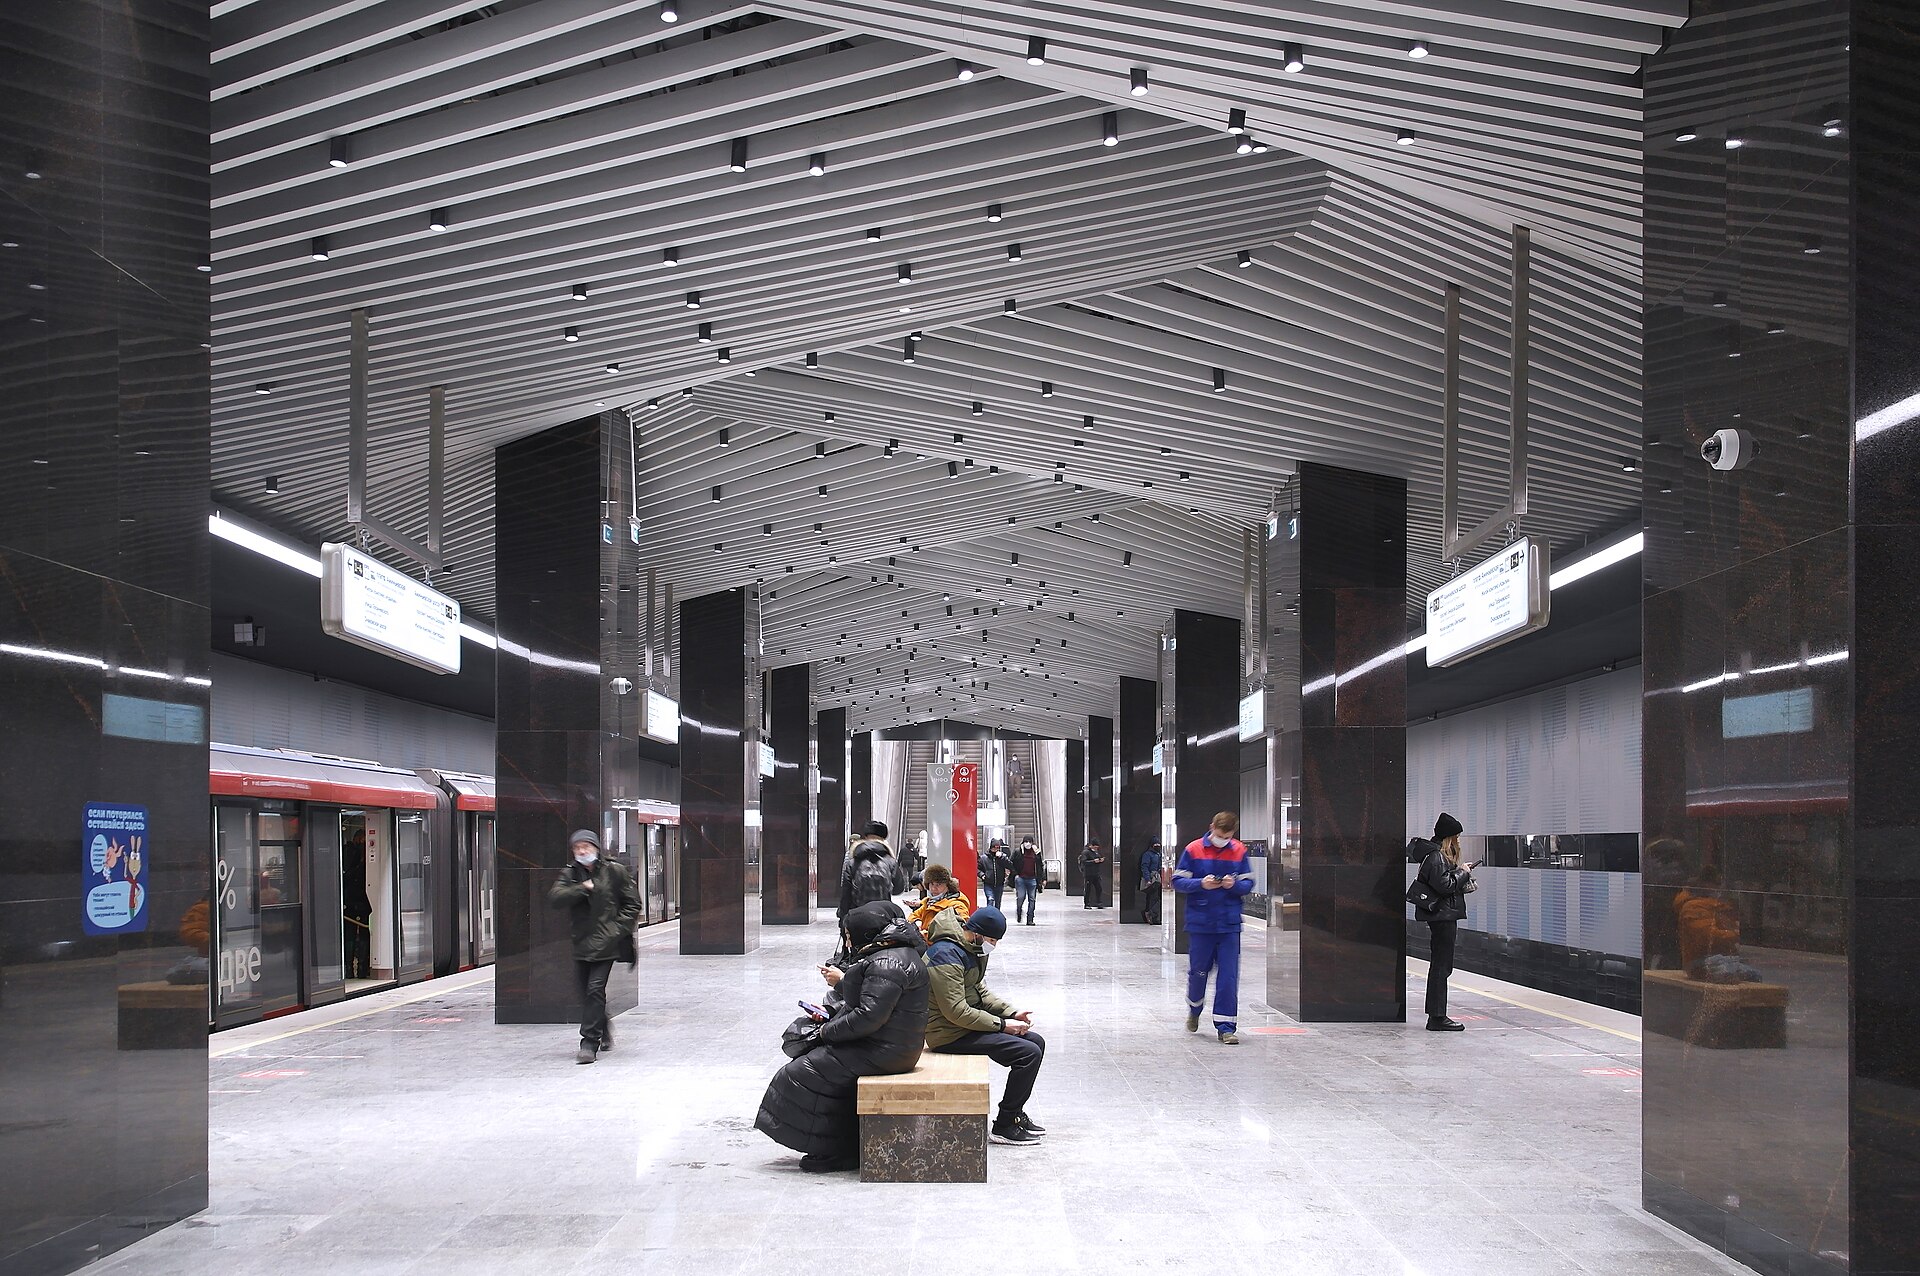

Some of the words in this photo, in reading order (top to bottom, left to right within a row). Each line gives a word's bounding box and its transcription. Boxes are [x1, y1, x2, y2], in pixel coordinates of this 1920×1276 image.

[88, 808, 106, 818] если
[106, 809, 144, 821] потерялся,
[87, 819, 124, 830] оставайся
[125, 821, 145, 832] здесь
